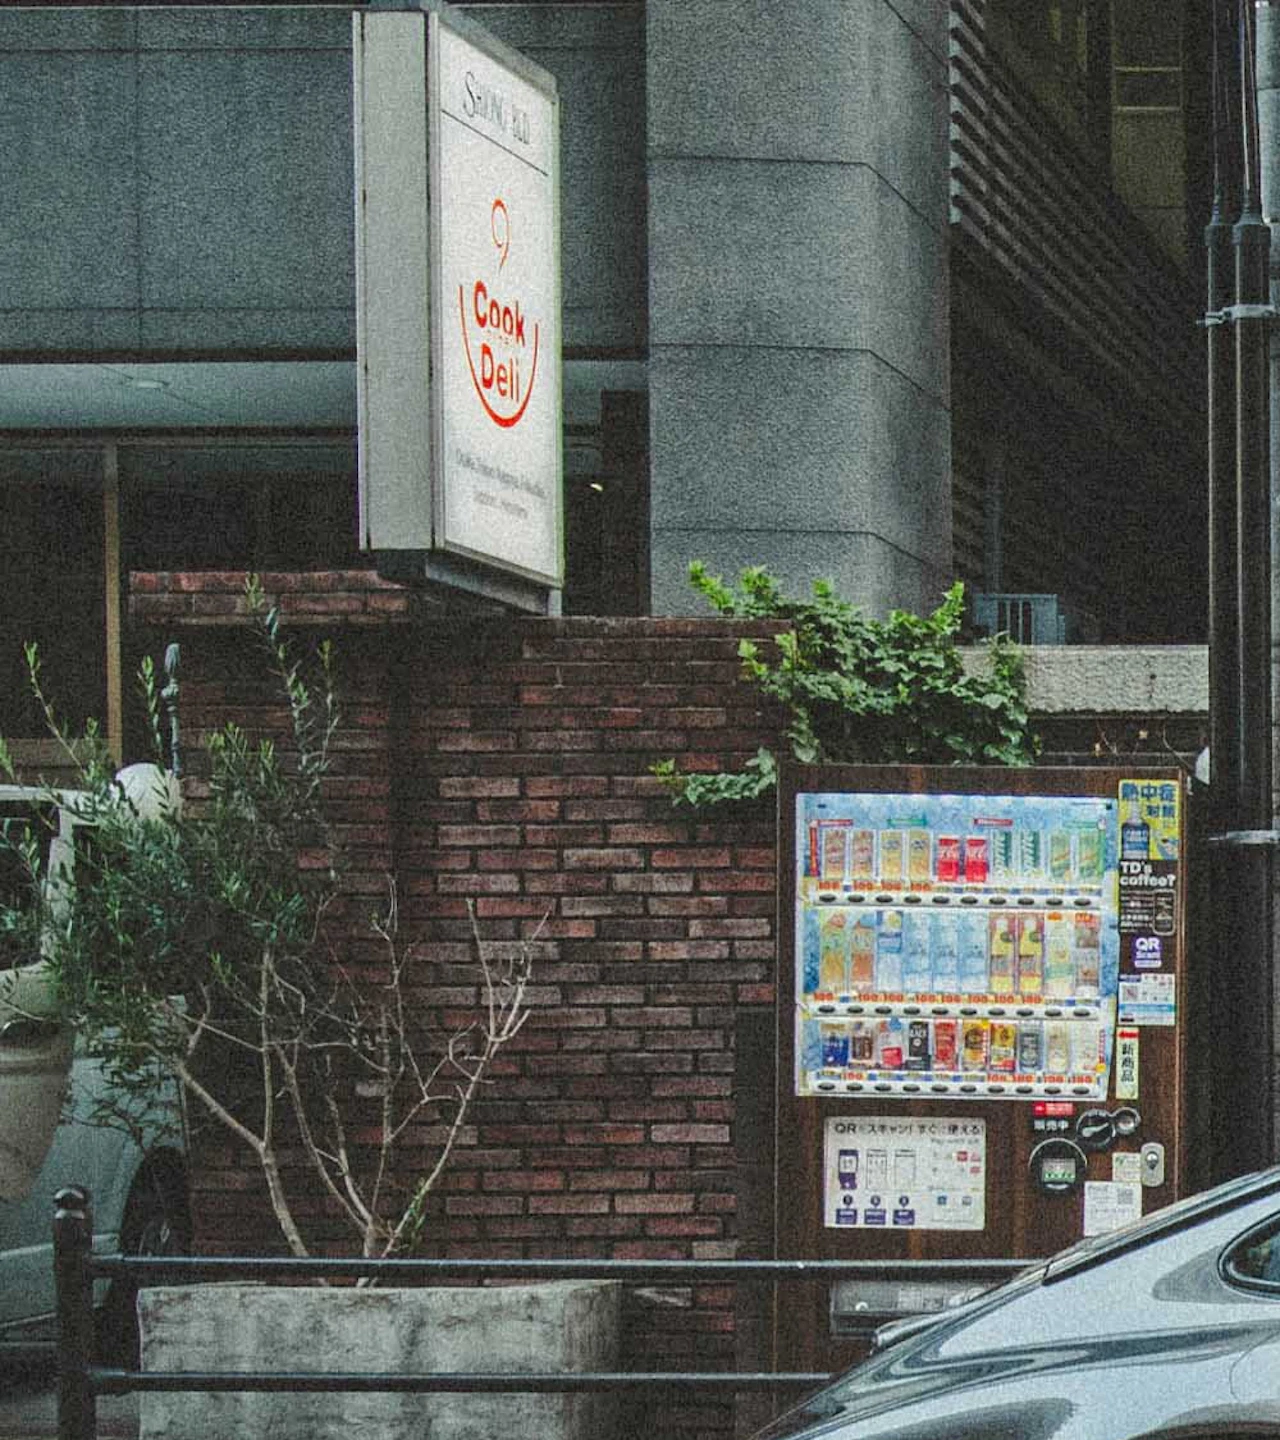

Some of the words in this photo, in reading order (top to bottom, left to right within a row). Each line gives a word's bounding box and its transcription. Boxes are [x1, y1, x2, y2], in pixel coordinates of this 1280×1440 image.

[474, 280, 525, 348] Cook
[481, 342, 520, 403] Deli
[1119, 874, 1177, 887] coffee?
[1120, 861, 1153, 874] TD's
[1135, 937, 1161, 952] QR
[1120, 1043, 1134, 1083] 新商品
